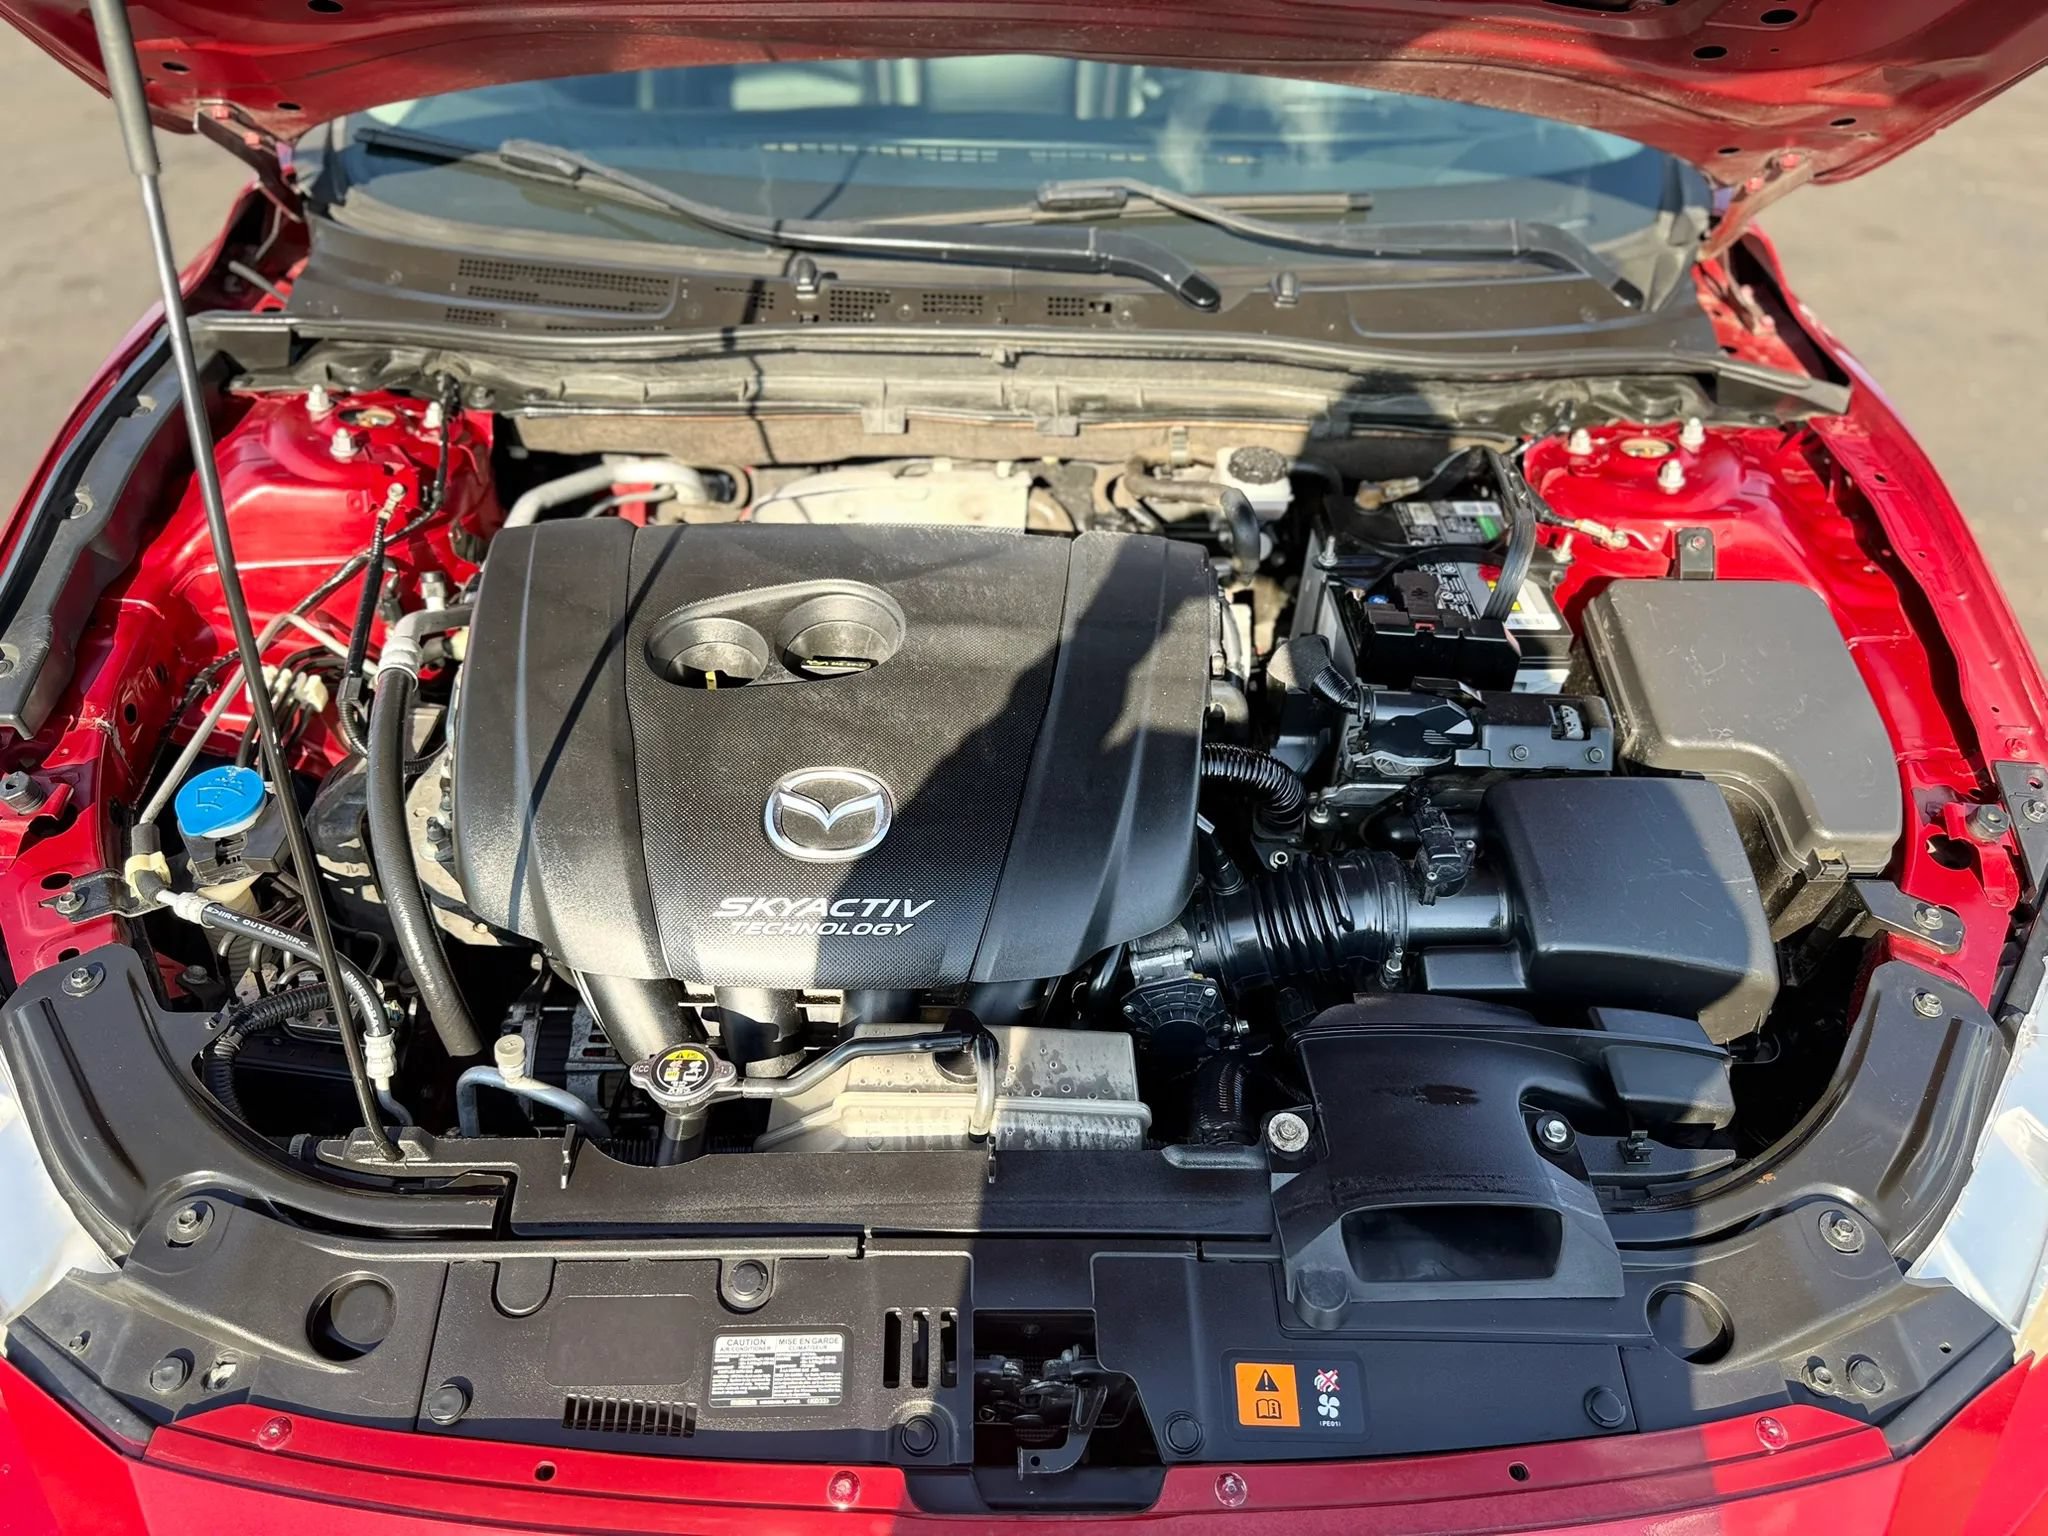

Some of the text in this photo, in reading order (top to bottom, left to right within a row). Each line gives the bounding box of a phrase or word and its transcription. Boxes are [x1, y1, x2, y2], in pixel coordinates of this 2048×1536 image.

[712, 896, 936, 918] SKYACTIV
[730, 921, 915, 936] TECHNOLOGY
[726, 1338, 766, 1346] CAUTION
[778, 1337, 839, 1345] MISE EN GARDE
